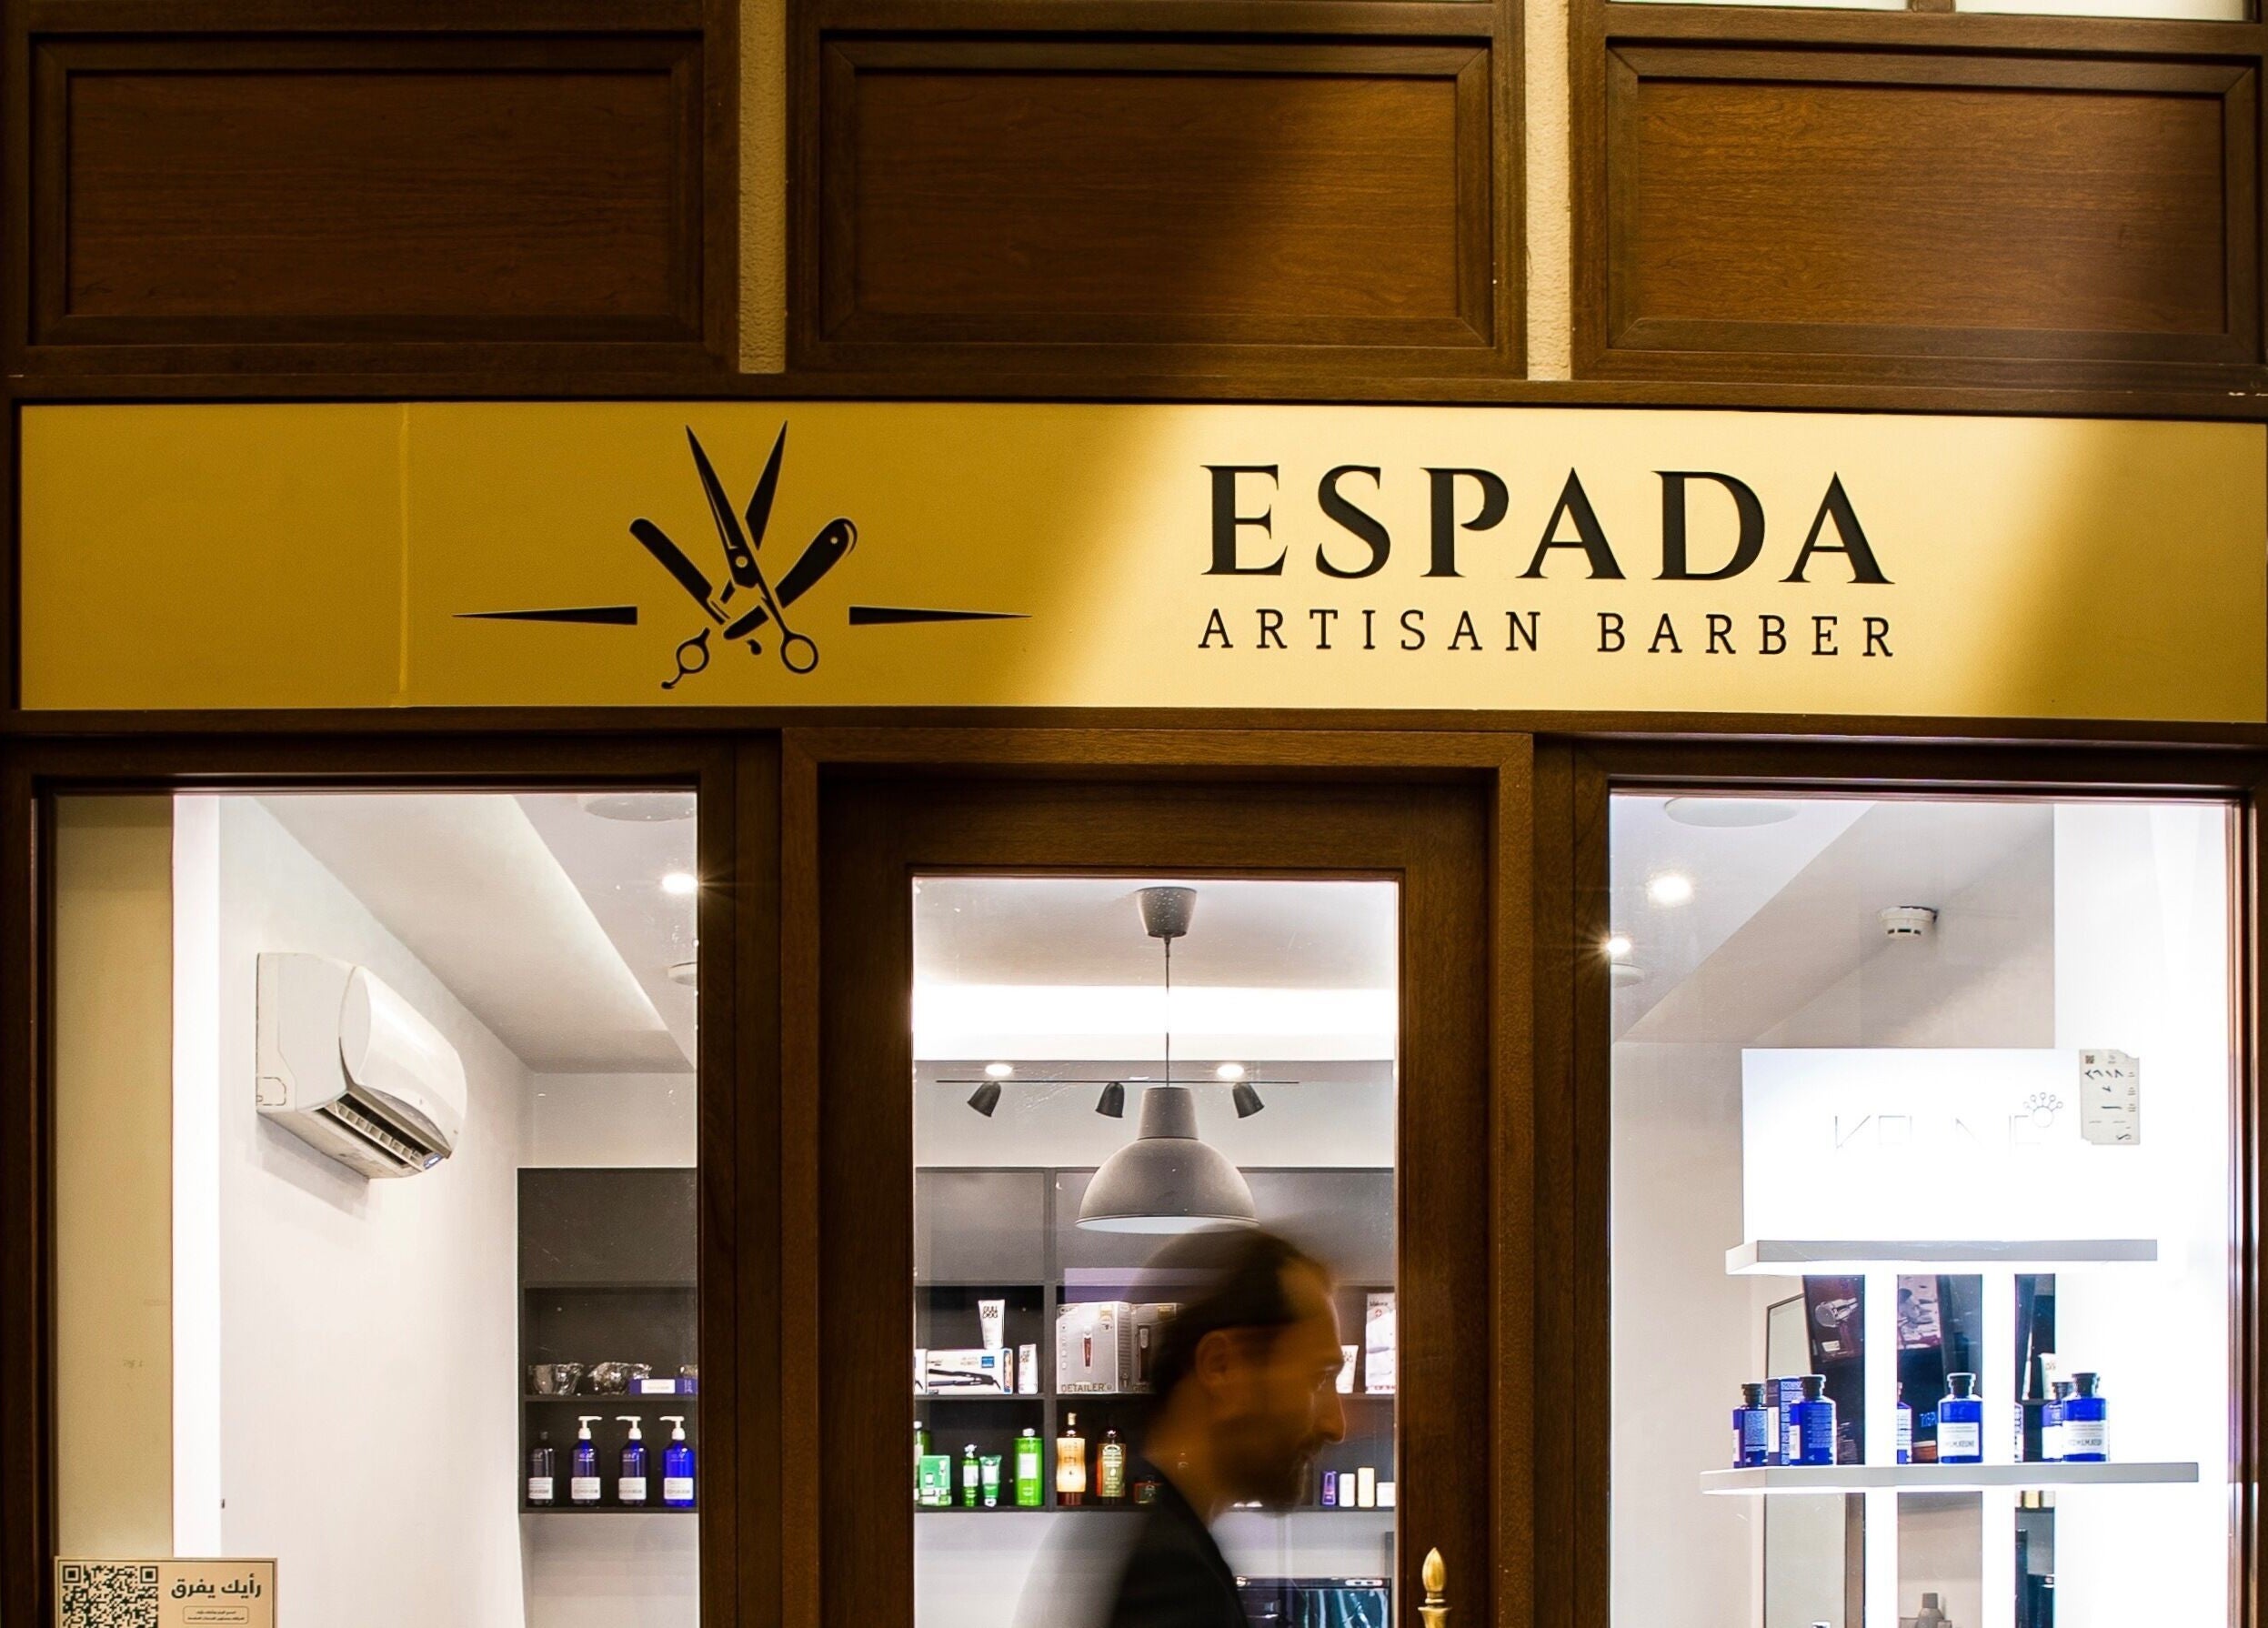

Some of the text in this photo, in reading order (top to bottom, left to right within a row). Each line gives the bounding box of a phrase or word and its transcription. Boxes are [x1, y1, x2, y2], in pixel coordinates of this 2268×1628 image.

[1200, 464, 1895, 585] ESPADA
[1198, 608, 1893, 658] ARTISAN BARBER
[1060, 1383, 1105, 1392] DETAILER
[171, 1573, 262, 1599] رأيك يفرق
